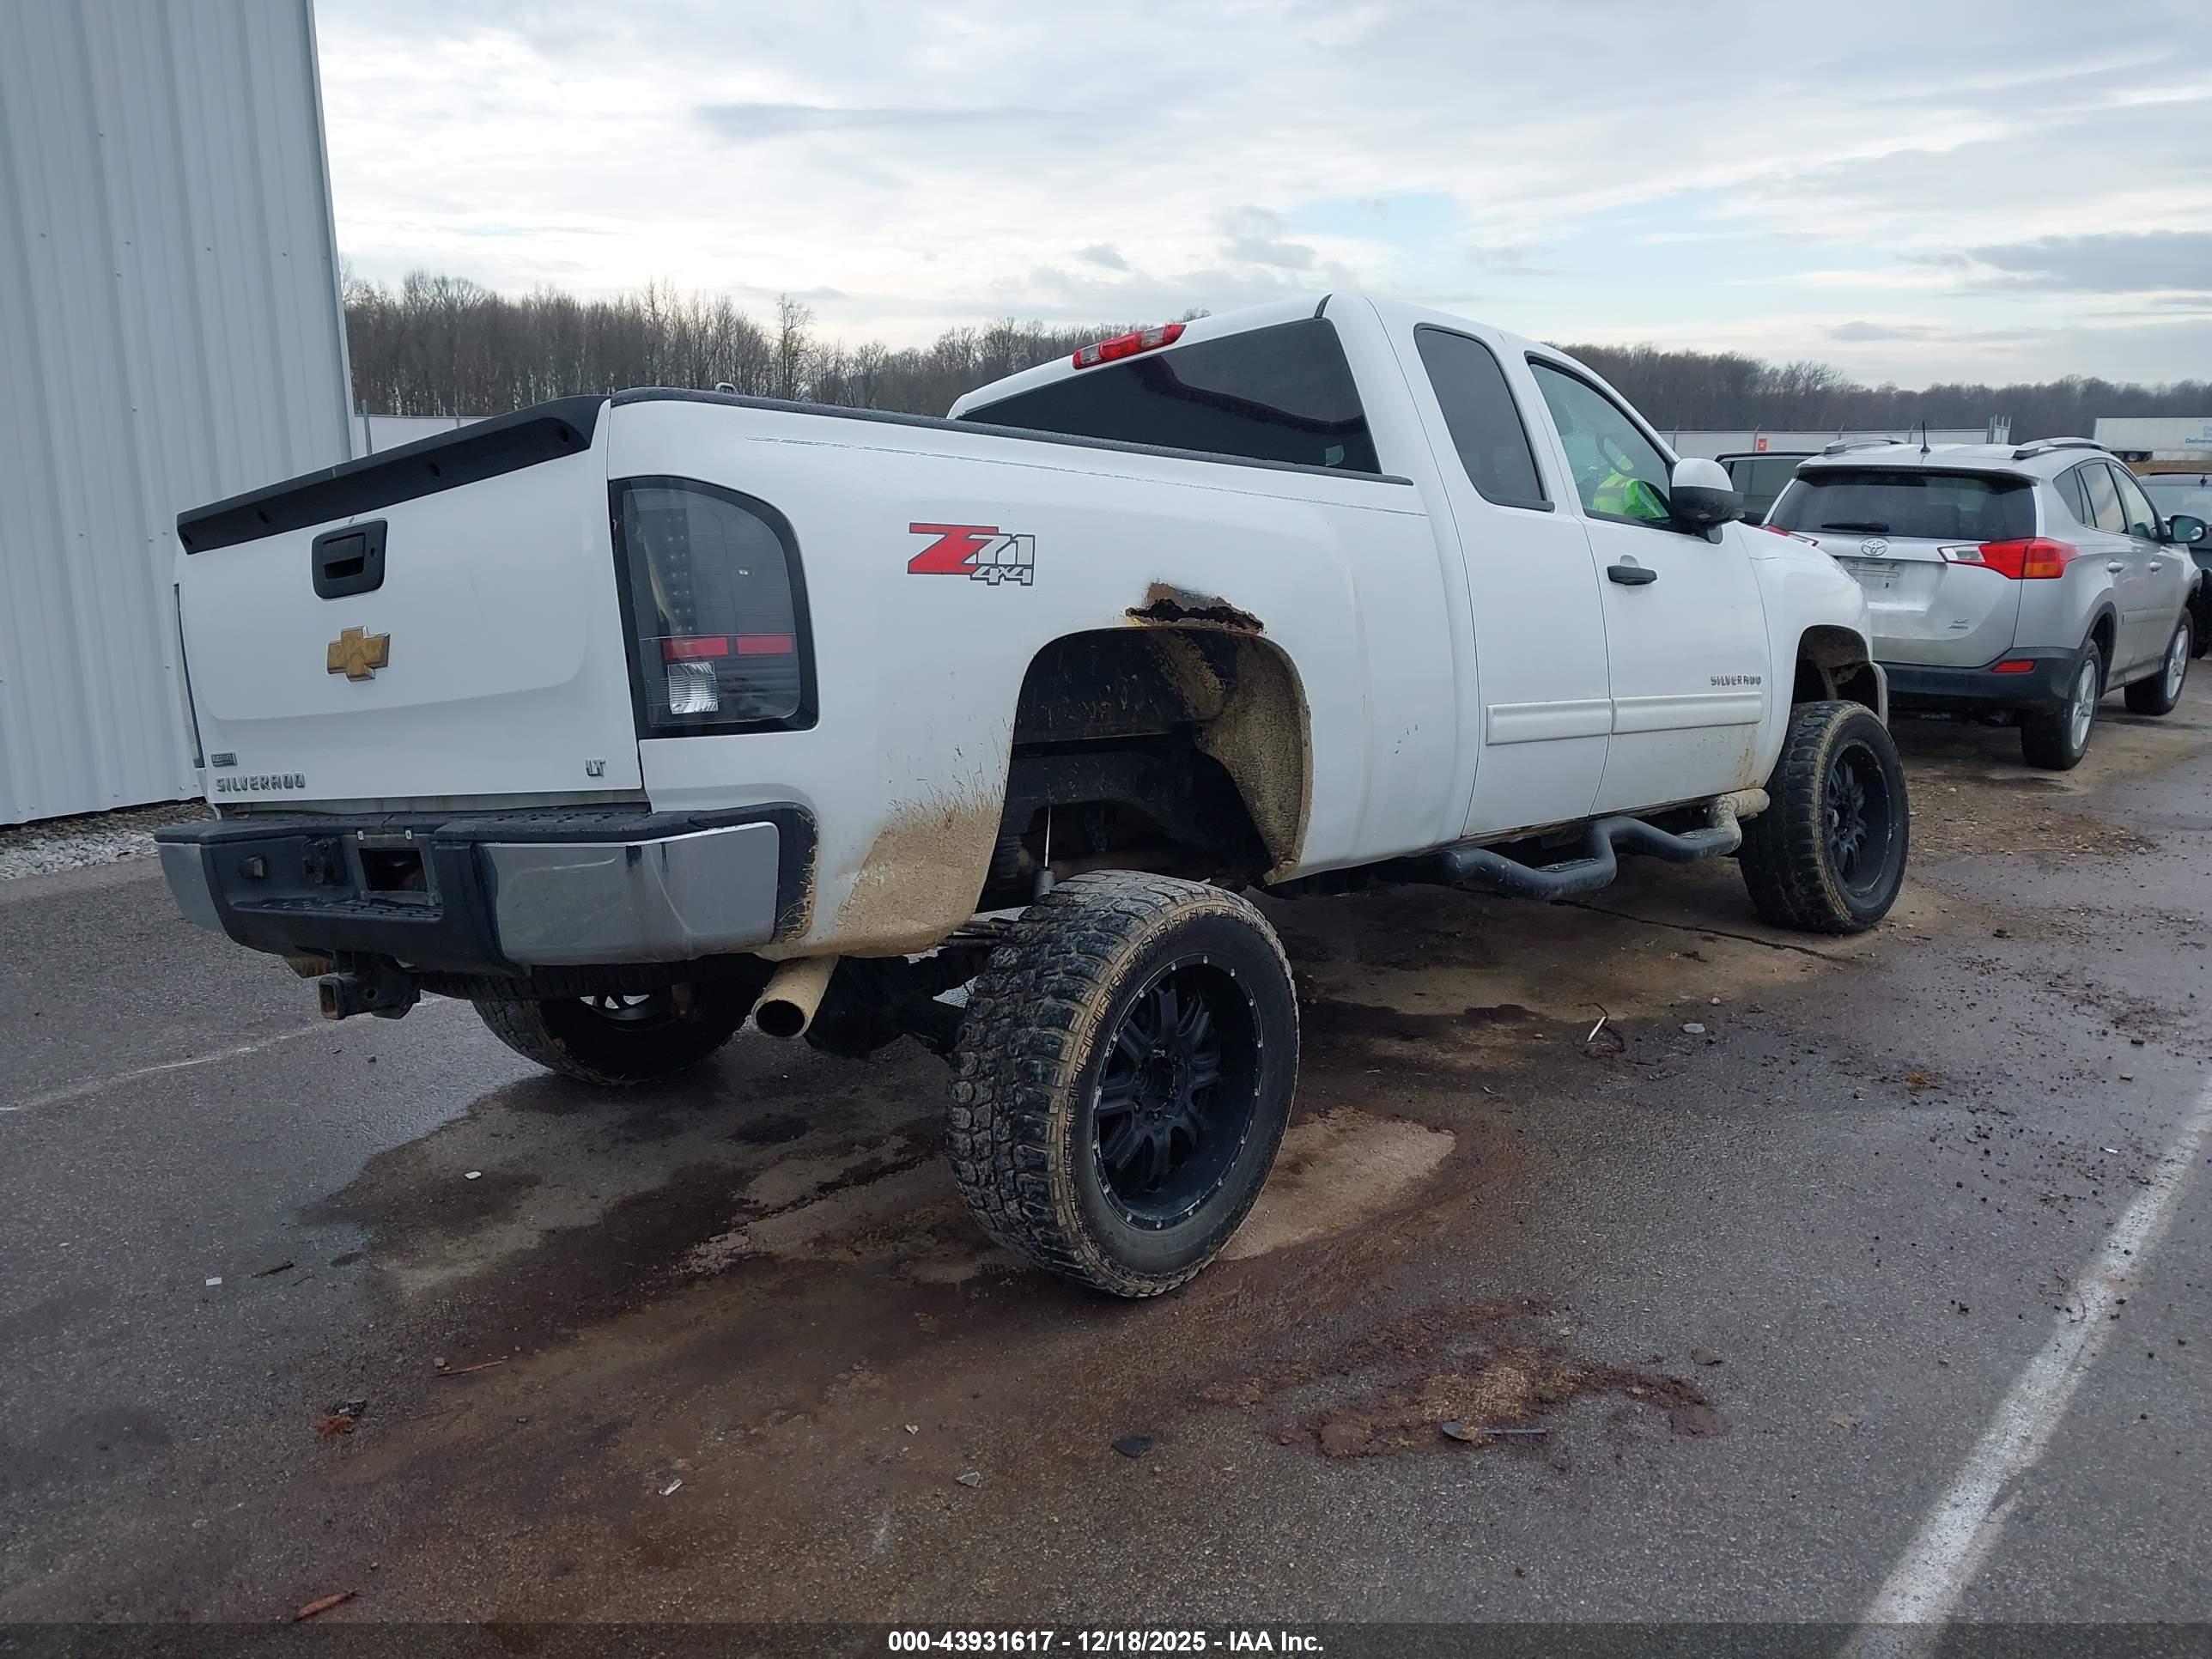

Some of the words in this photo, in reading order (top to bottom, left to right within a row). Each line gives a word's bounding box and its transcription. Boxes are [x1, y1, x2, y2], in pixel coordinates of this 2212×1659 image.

[908, 523, 1035, 574] Z71
[1711, 675, 1762, 686] SILVERADO
[585, 759, 605, 777] LT
[216, 773, 306, 792] SILVERADO
